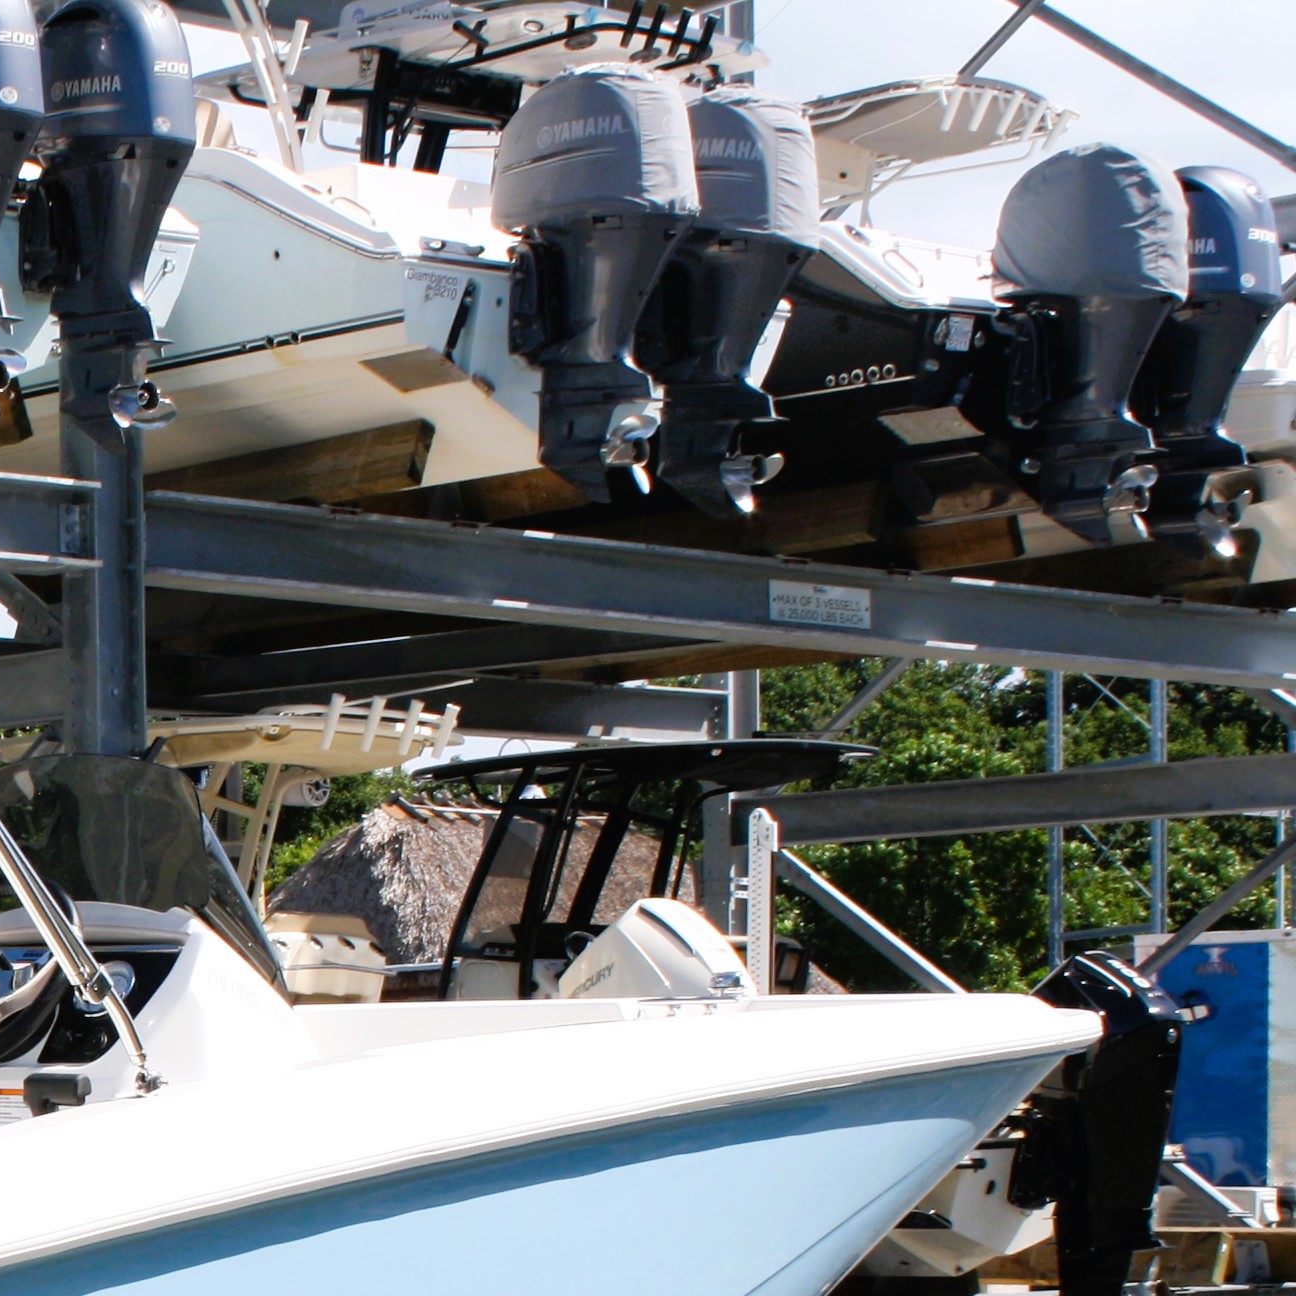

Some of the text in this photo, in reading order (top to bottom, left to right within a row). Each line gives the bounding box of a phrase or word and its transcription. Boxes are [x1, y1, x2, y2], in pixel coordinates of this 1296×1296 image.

[153, 61, 189, 75] 200
[64, 74, 122, 98] YAMAHA
[553, 114, 623, 142] YAMAHA
[777, 594, 797, 606] MAX
[800, 596, 813, 607] OF
[823, 598, 862, 612] VESSELS
[821, 611, 838, 623] LBS
[840, 612, 864, 625] EACH
